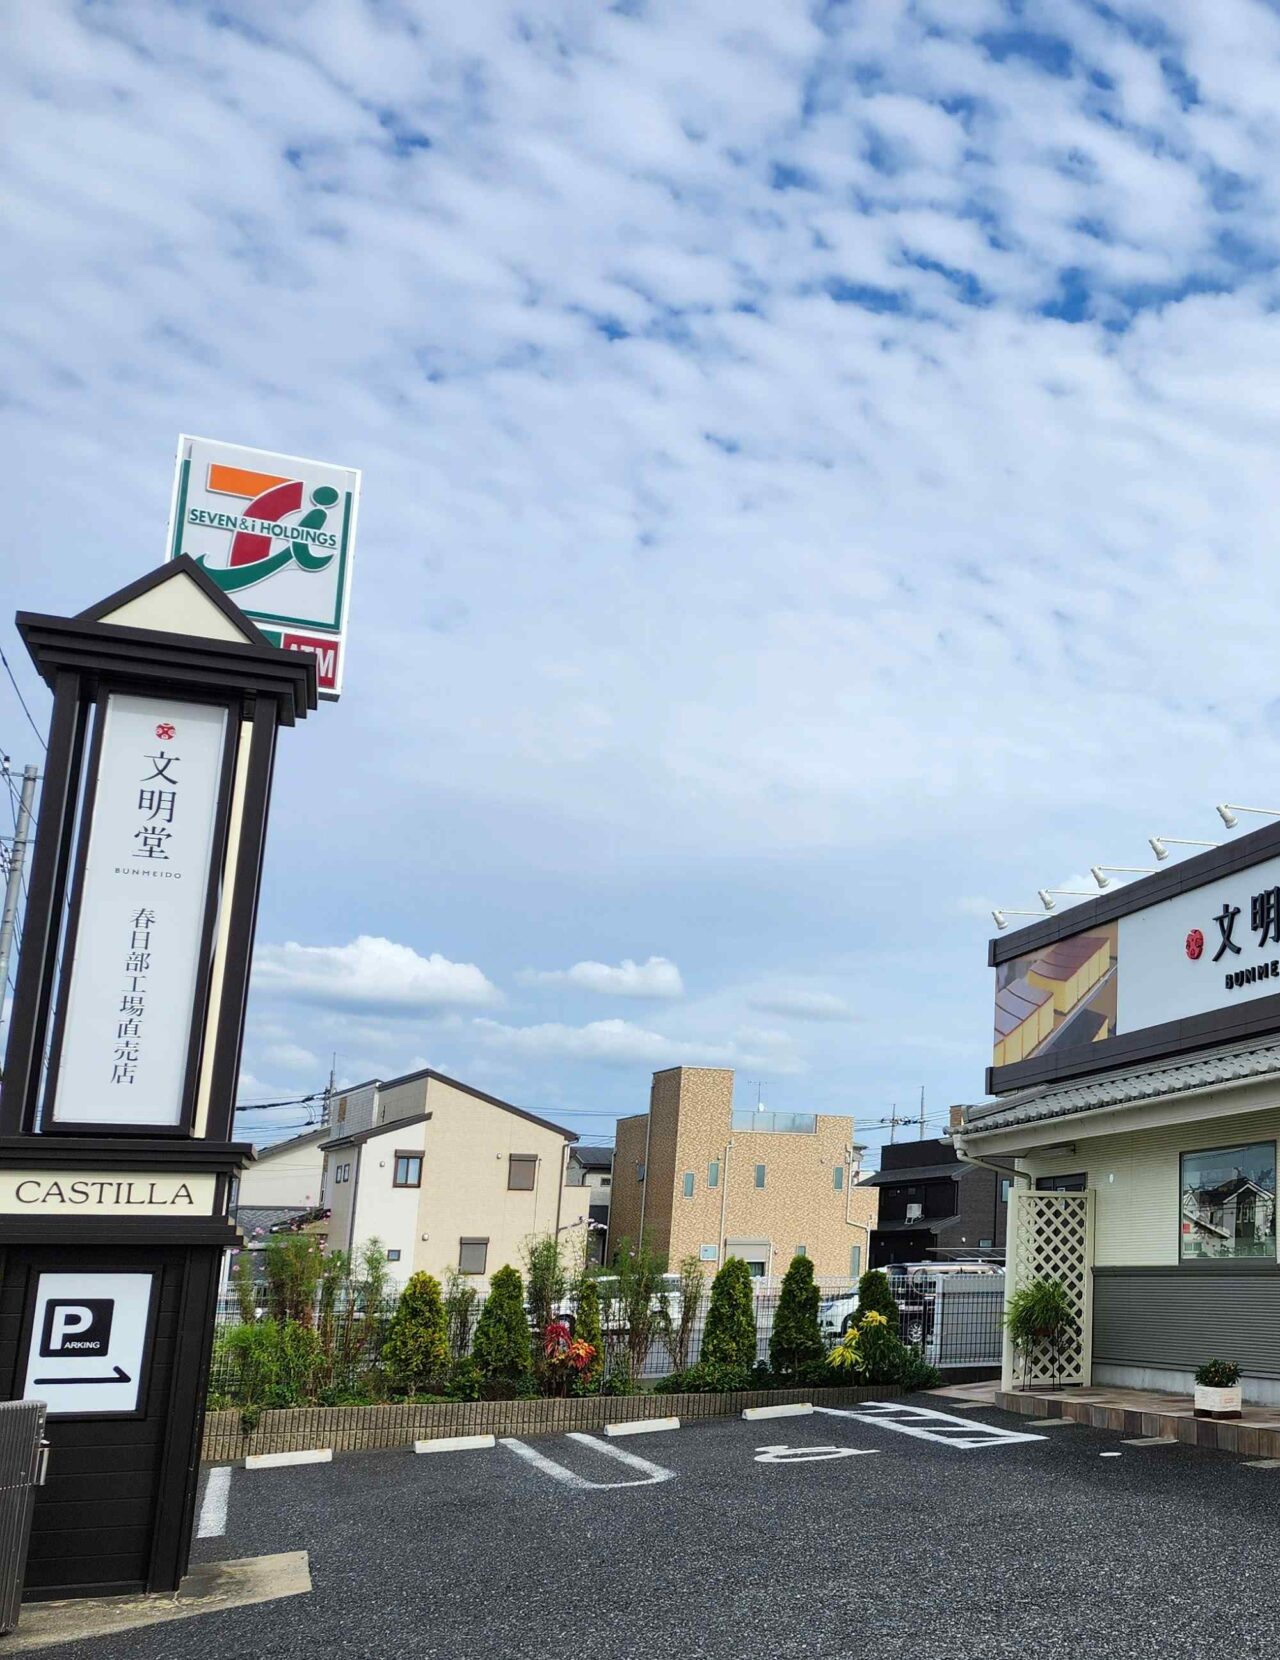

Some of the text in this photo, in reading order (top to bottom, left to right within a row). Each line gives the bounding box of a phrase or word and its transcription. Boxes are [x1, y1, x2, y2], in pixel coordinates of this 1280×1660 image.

[260, 522, 337, 547] HOLDINGS
[131, 750, 182, 861] 文明堂
[114, 867, 183, 879] BUNMEIDO
[110, 907, 156, 1085] 春日部工場直売店
[14, 1180, 195, 1205] CASTILLA
